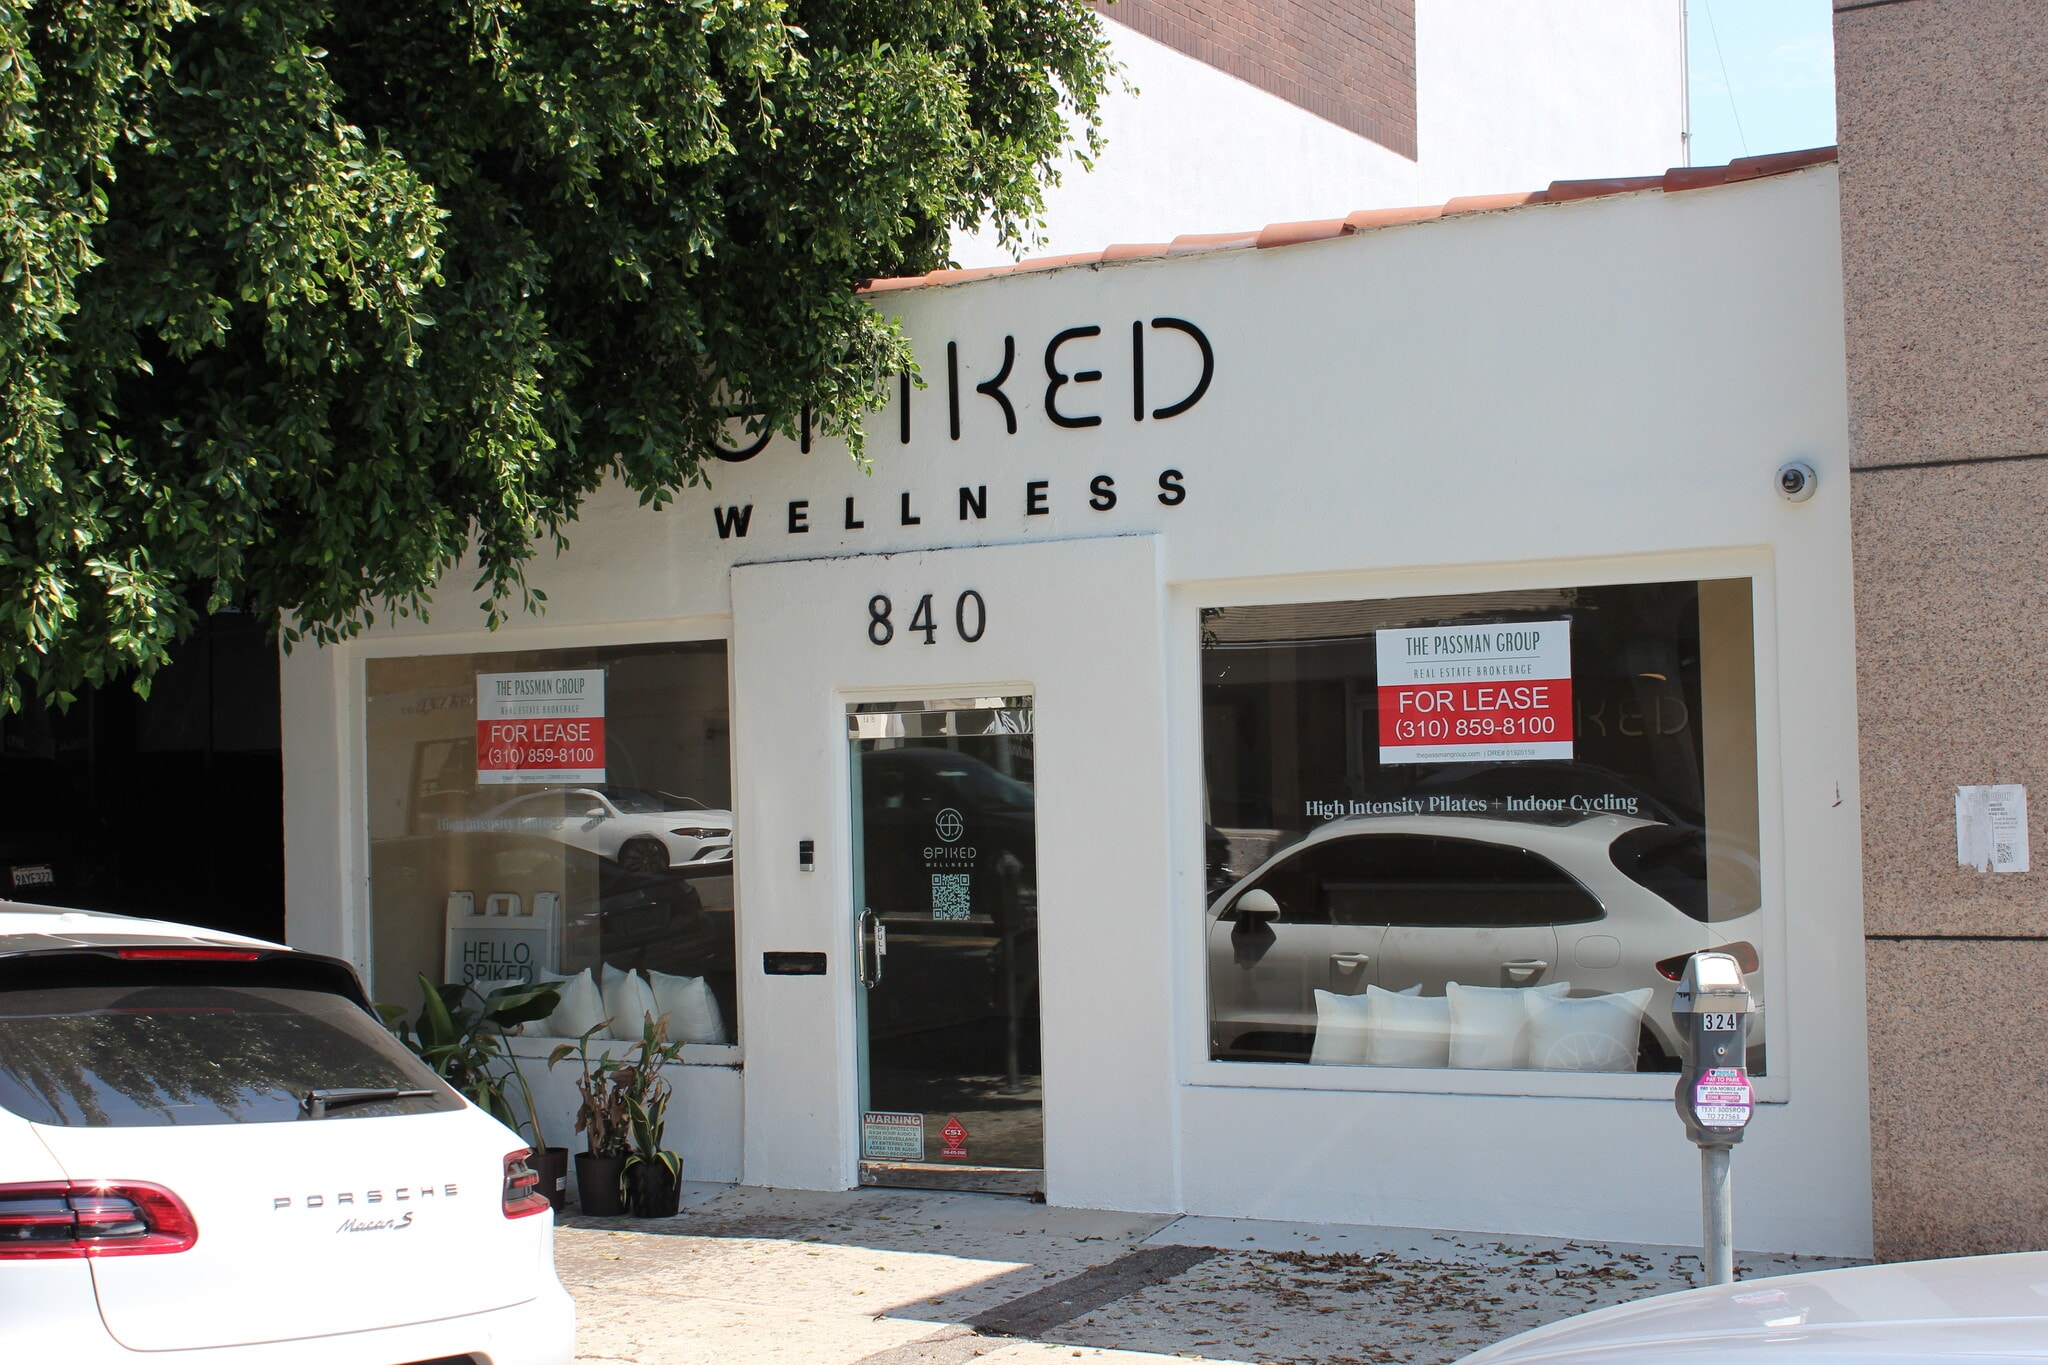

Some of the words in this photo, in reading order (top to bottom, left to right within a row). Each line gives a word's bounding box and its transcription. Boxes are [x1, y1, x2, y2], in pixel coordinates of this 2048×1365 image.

[712, 317, 1214, 462] IKED
[714, 469, 1186, 539] WELLNESS
[868, 589, 987, 645] 840
[1406, 636, 1429, 656] THE
[1434, 633, 1491, 655] PASSMAN
[1496, 631, 1540, 653] GROUP
[1414, 668, 1437, 679] REAL
[1440, 666, 1472, 678] ESTATE
[1476, 664, 1532, 676] BROKERAGE
[496, 680, 512, 696] THE
[515, 679, 552, 696] PASSMAN
[556, 678, 584, 695] GROUP
[500, 707, 516, 715] REAL
[518, 706, 540, 714] ESTATE
[542, 705, 580, 714] BROKERAGE
[1398, 690, 1454, 714] FOR
[1462, 686, 1549, 712] LEASE
[492, 725, 528, 743] FOR
[534, 724, 590, 742] LEASE
[1394, 719, 1449, 740] (310)
[1456, 715, 1555, 737] 859-8100
[488, 748, 524, 766] (310)
[528, 748, 594, 763] 859-8100
[1416, 751, 1480, 759] thepassmangroup.com
[1306, 799, 1344, 820] High
[1348, 798, 1424, 818] Intensity
[1428, 796, 1488, 813] Pilates
[1506, 794, 1566, 812] Indoor
[1570, 793, 1638, 816] Cycling
[923, 847, 976, 859] SPIKED
[464, 942, 534, 968] HELLO,
[1706, 1014, 1735, 1030] 324
[865, 1115, 920, 1124] WARNING
[274, 1184, 458, 1210] PORSCHE
[336, 1218, 394, 1234] Macan
[394, 1212, 413, 1230] S
